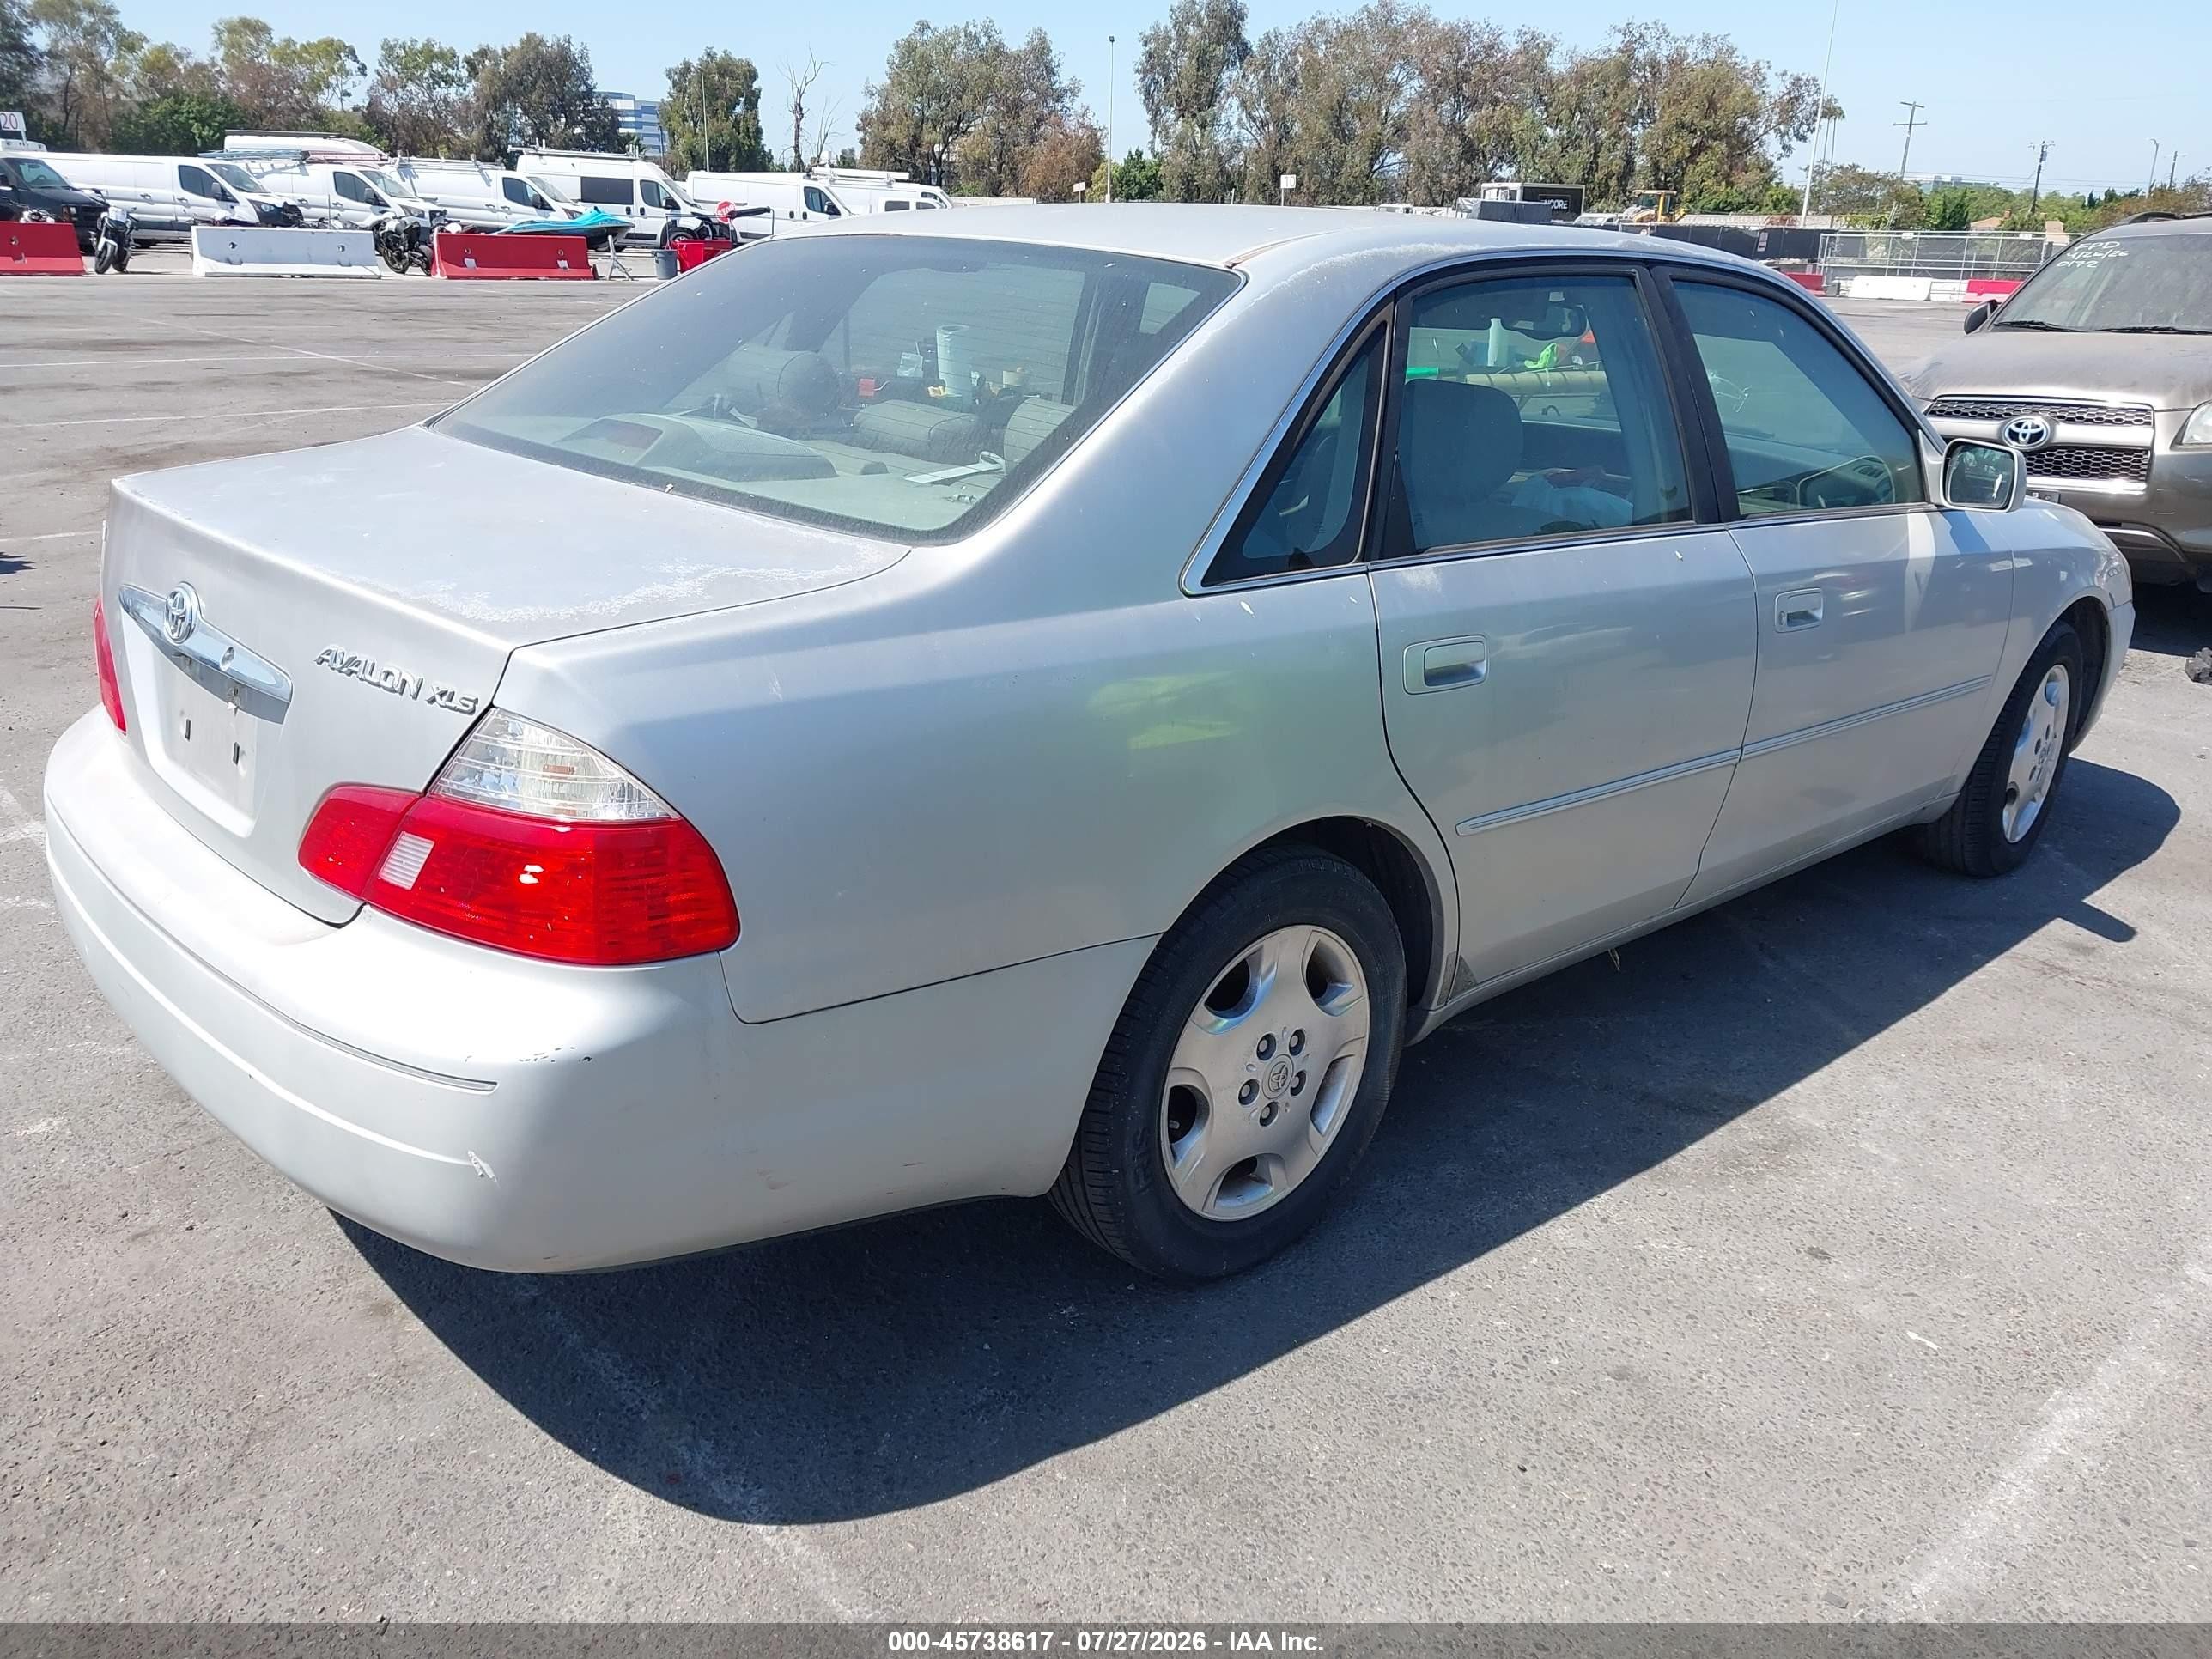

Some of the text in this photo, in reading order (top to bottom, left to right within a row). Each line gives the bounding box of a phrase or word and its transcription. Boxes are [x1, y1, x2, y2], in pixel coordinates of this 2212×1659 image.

[1285, 176, 1296, 187] 10
[2074, 241, 2121, 252] FPD
[314, 645, 479, 715] AVALON XLS
